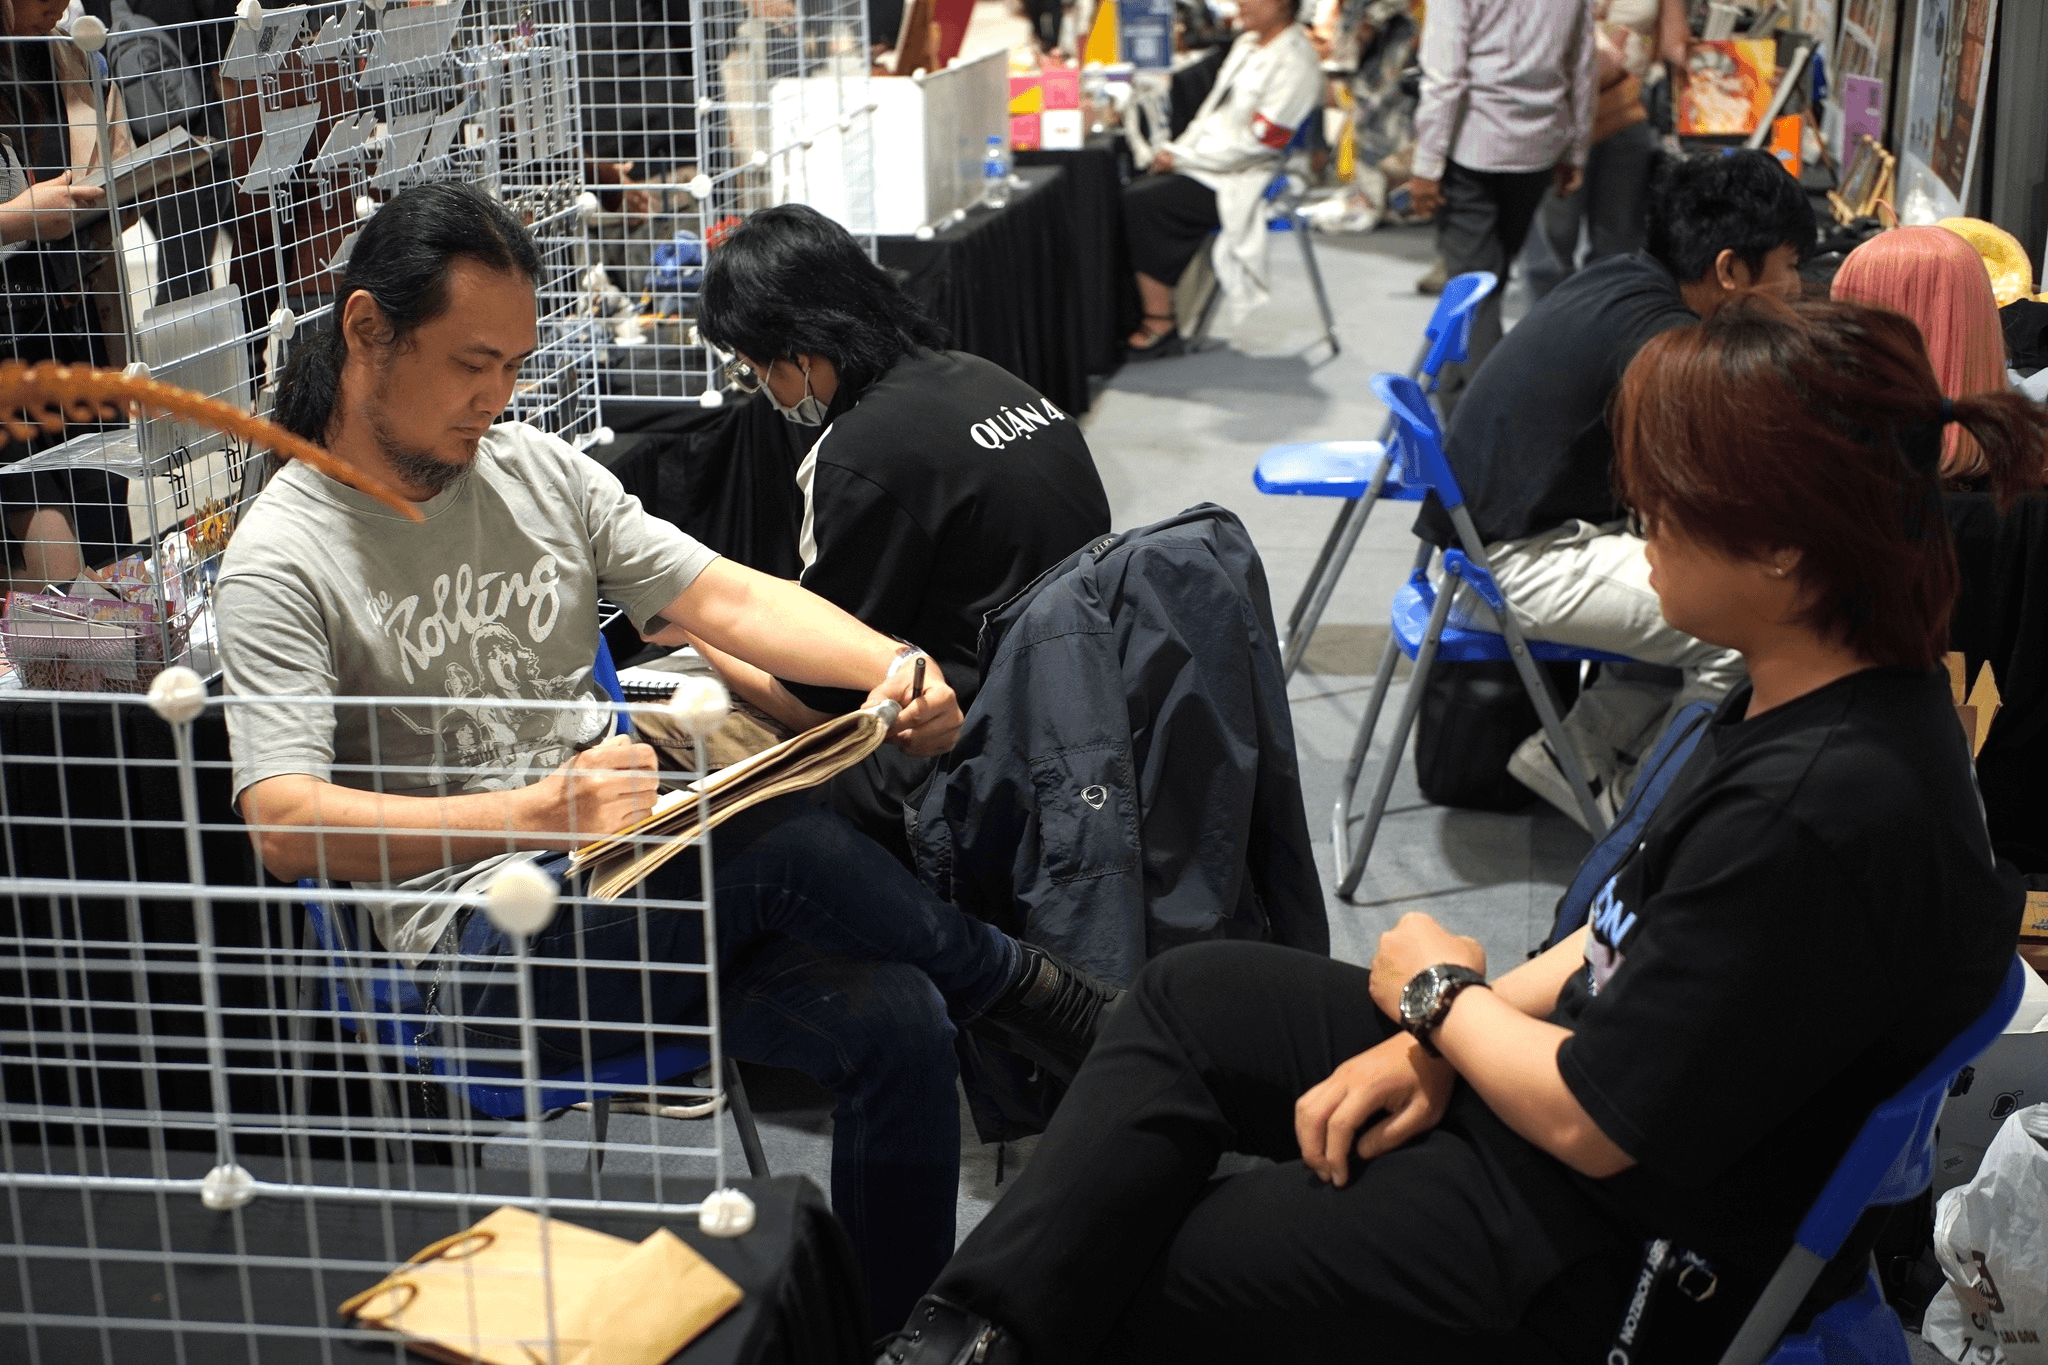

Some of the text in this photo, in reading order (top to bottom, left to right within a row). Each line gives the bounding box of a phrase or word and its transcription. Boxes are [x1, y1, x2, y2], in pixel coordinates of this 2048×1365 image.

[970, 398, 1066, 450] QUẬN 4
[366, 554, 560, 685] the Rolling
